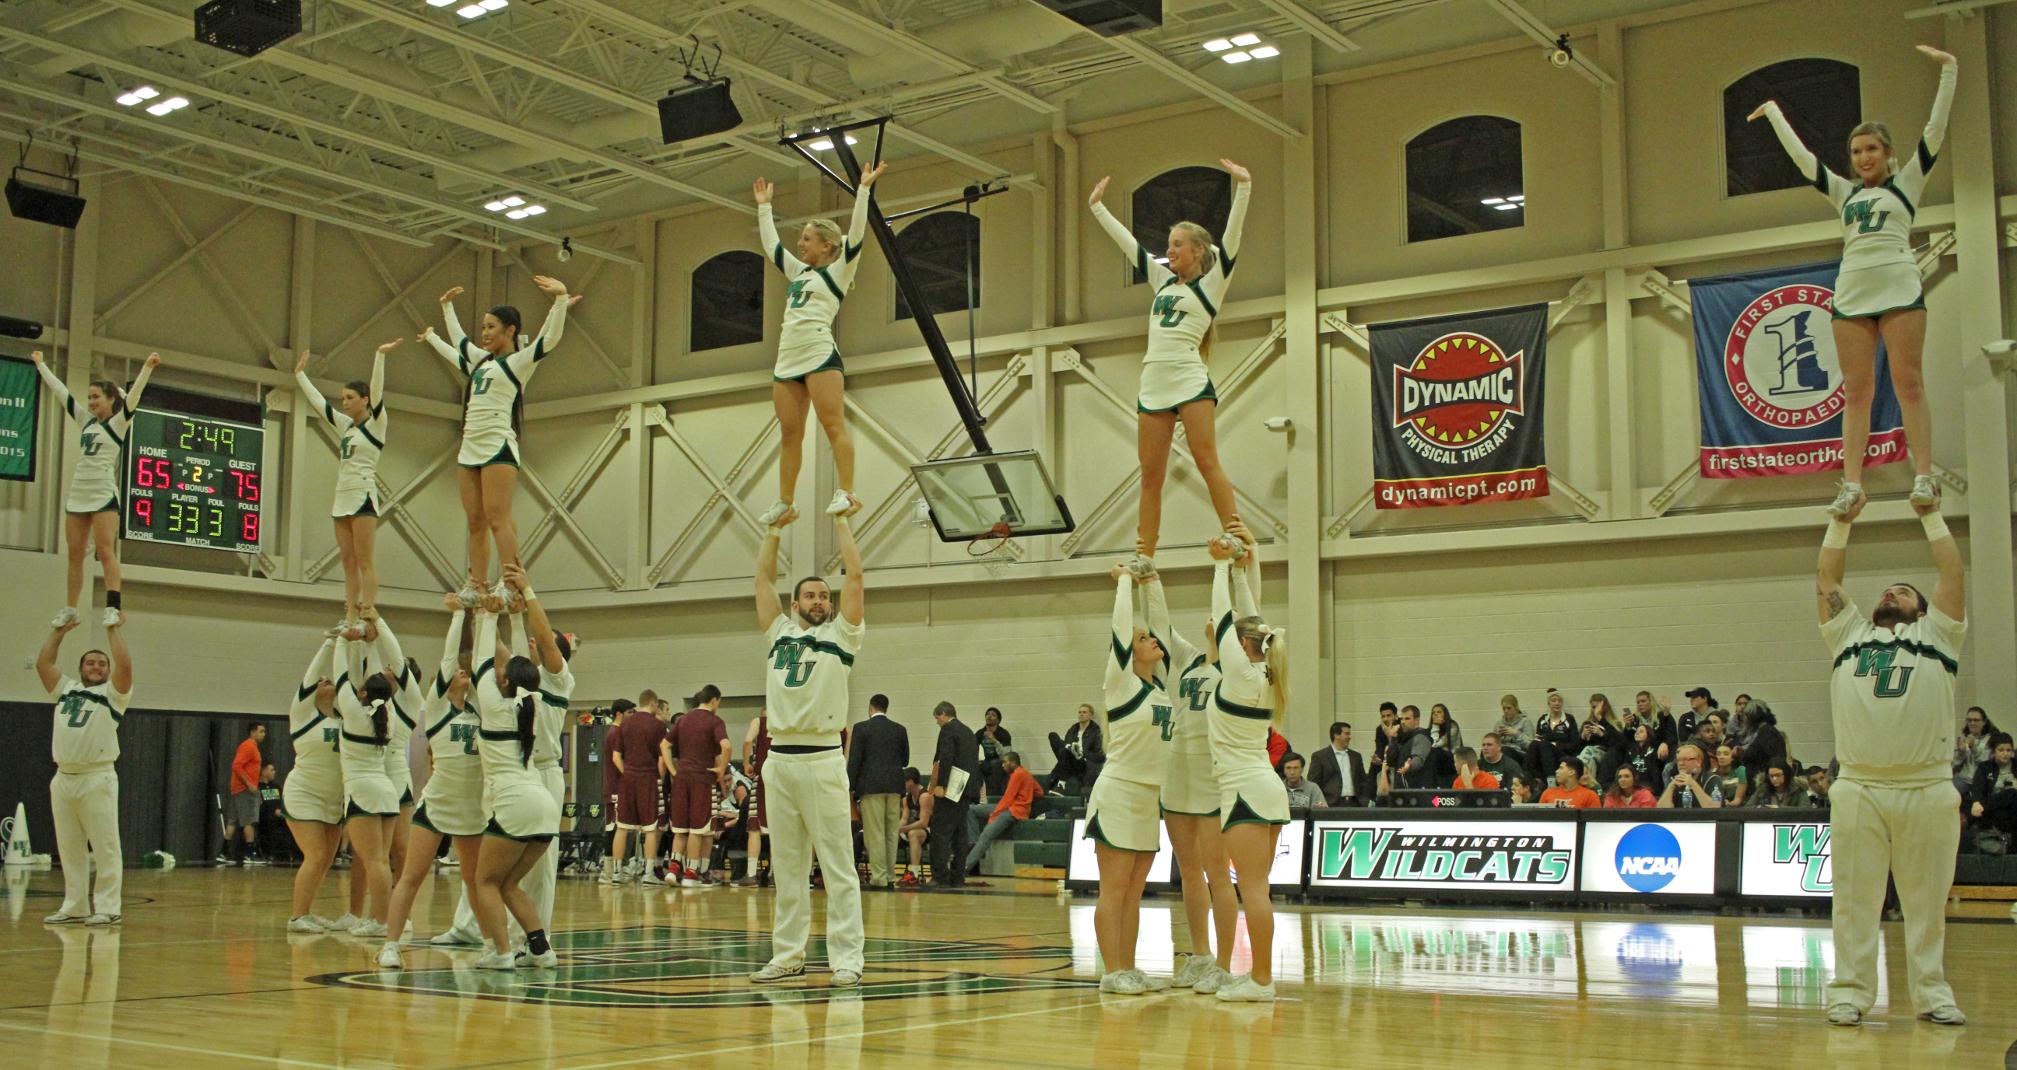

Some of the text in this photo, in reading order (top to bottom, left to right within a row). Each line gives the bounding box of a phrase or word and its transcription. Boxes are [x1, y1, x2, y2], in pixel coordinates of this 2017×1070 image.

[1845, 197, 1891, 234] WU
[785, 279, 815, 308] WU
[1153, 295, 1188, 328] WU
[1735, 289, 1833, 339] FIRST STA
[1404, 366, 1514, 412] DYNAMIC
[0, 430, 18, 438] ns
[180, 422, 234, 455] 2:49
[1401, 419, 1516, 464] PHYSICAL THERAPY
[140, 446, 167, 458] HOME
[186, 456, 210, 466] PERIOD
[228, 459, 256, 471] GUEST
[1709, 440, 1897, 470] firststateorthoom
[138, 456, 171, 489] 65
[192, 465, 202, 482] 2
[230, 470, 259, 501] 75
[131, 488, 153, 498] FOULS
[172, 493, 224, 507] PLAYER FOUL
[184, 484, 209, 493] BONUS
[1382, 478, 1536, 504] dynamicpt.com
[136, 499, 151, 526] 9
[168, 503, 199, 534] 33
[238, 502, 259, 511] FOULS
[128, 530, 153, 540] SCORE
[209, 509, 222, 537] 3
[243, 513, 257, 540] 8
[186, 537, 210, 547] MATCH
[773, 643, 816, 688] WU
[1854, 646, 1914, 698] WU
[1179, 677, 1212, 711] WU
[61, 696, 93, 728] WU
[1438, 797, 1455, 806] POSS
[1318, 828, 1571, 883] WILDCATS
[1400, 836, 1546, 848] WILMINGTON
[1620, 856, 1680, 875] NCAA
